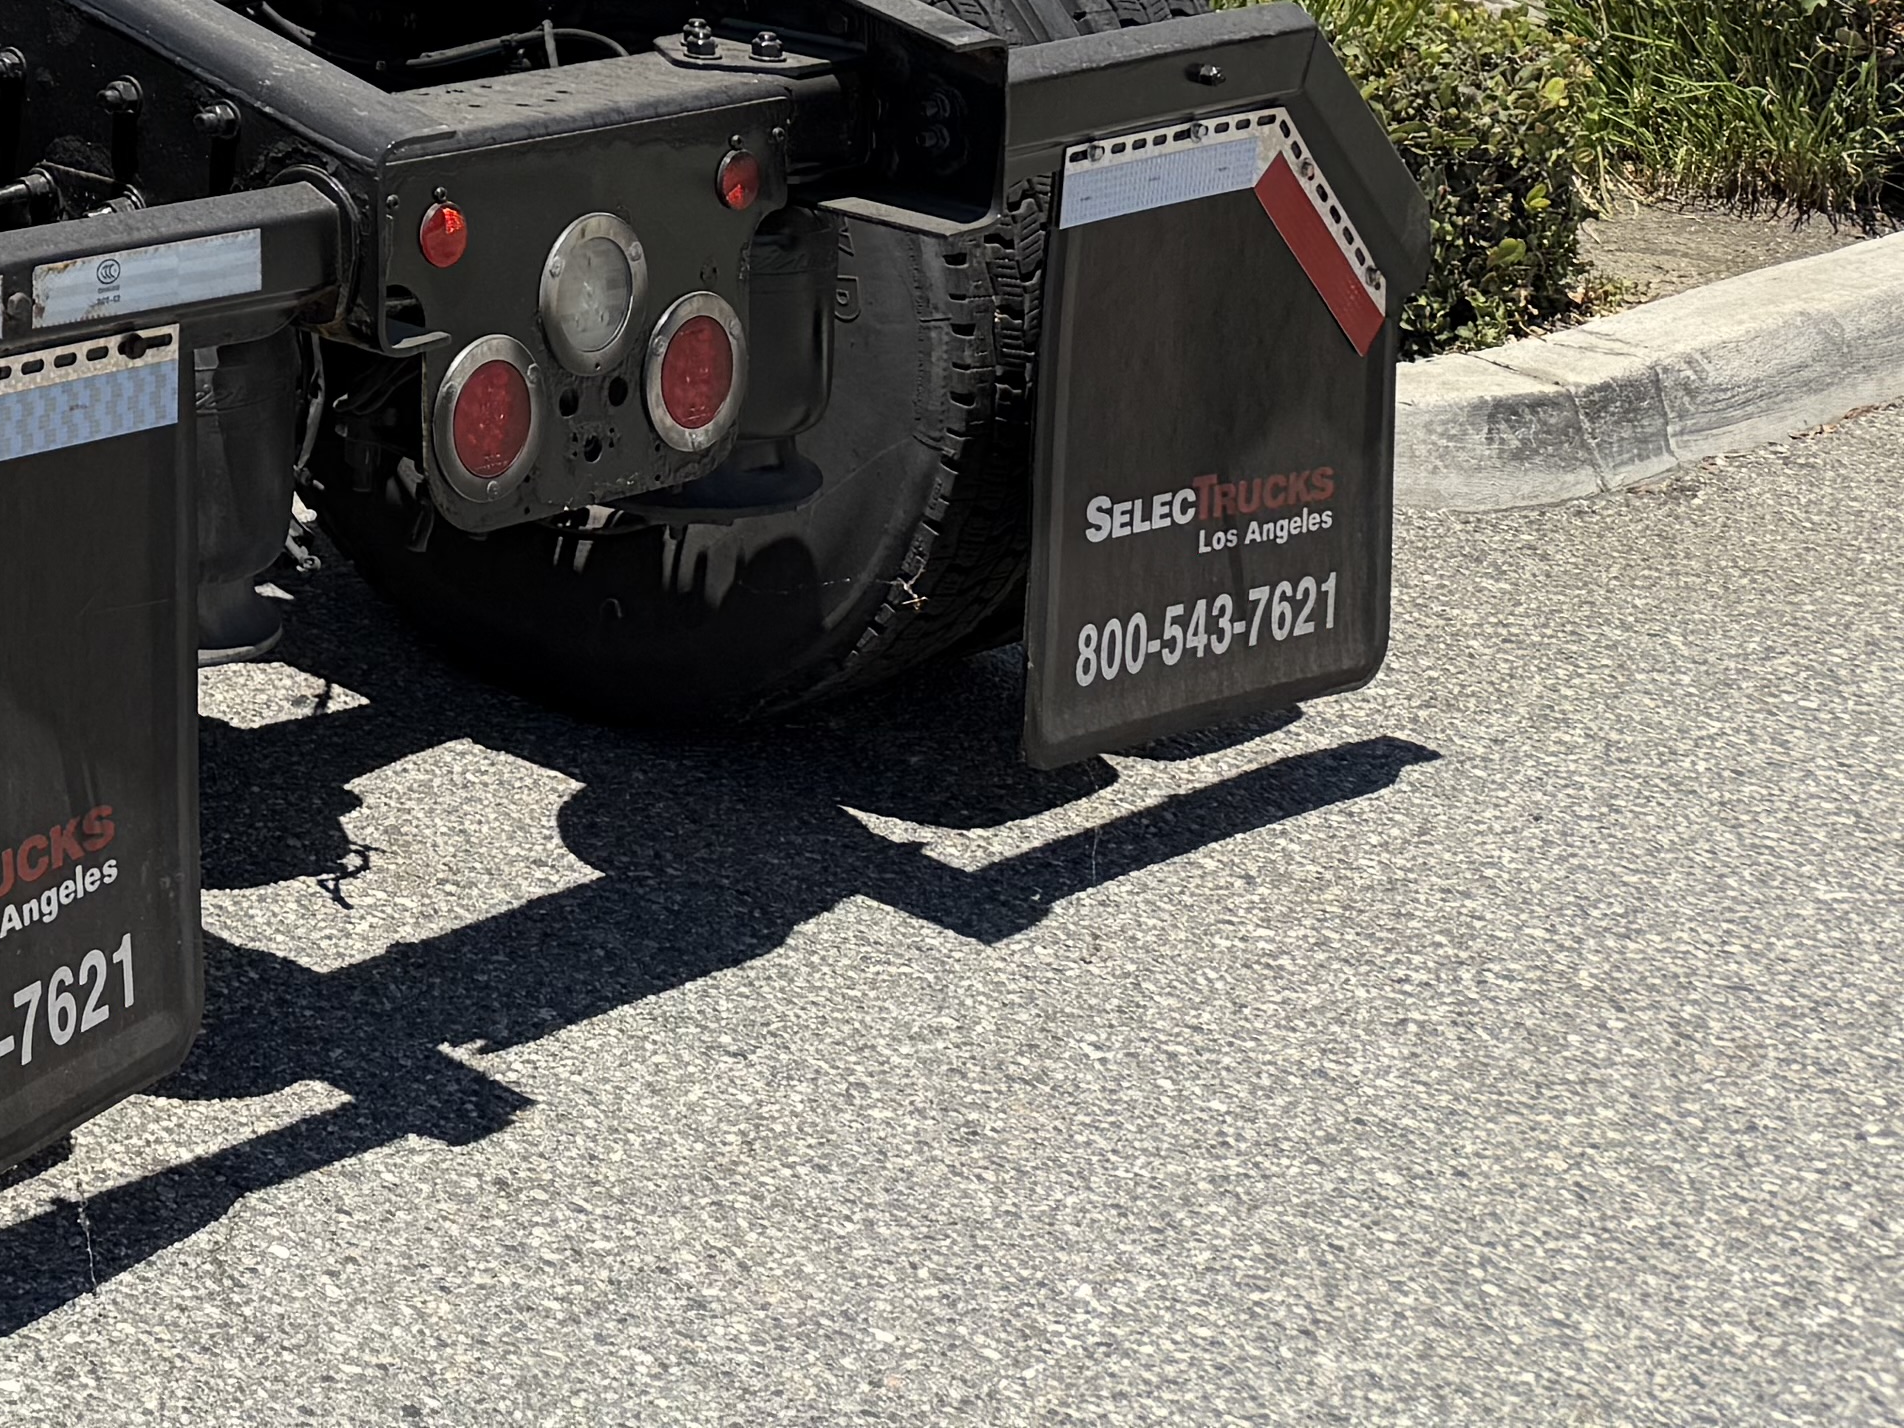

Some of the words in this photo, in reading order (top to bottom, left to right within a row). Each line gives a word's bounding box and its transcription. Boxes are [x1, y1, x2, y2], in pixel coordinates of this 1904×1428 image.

[1198, 529, 1238, 554] Los
[1244, 507, 1334, 545] Angeles
[1075, 571, 1337, 687] 800-543-7621
[0, 859, 119, 939] Angeles
